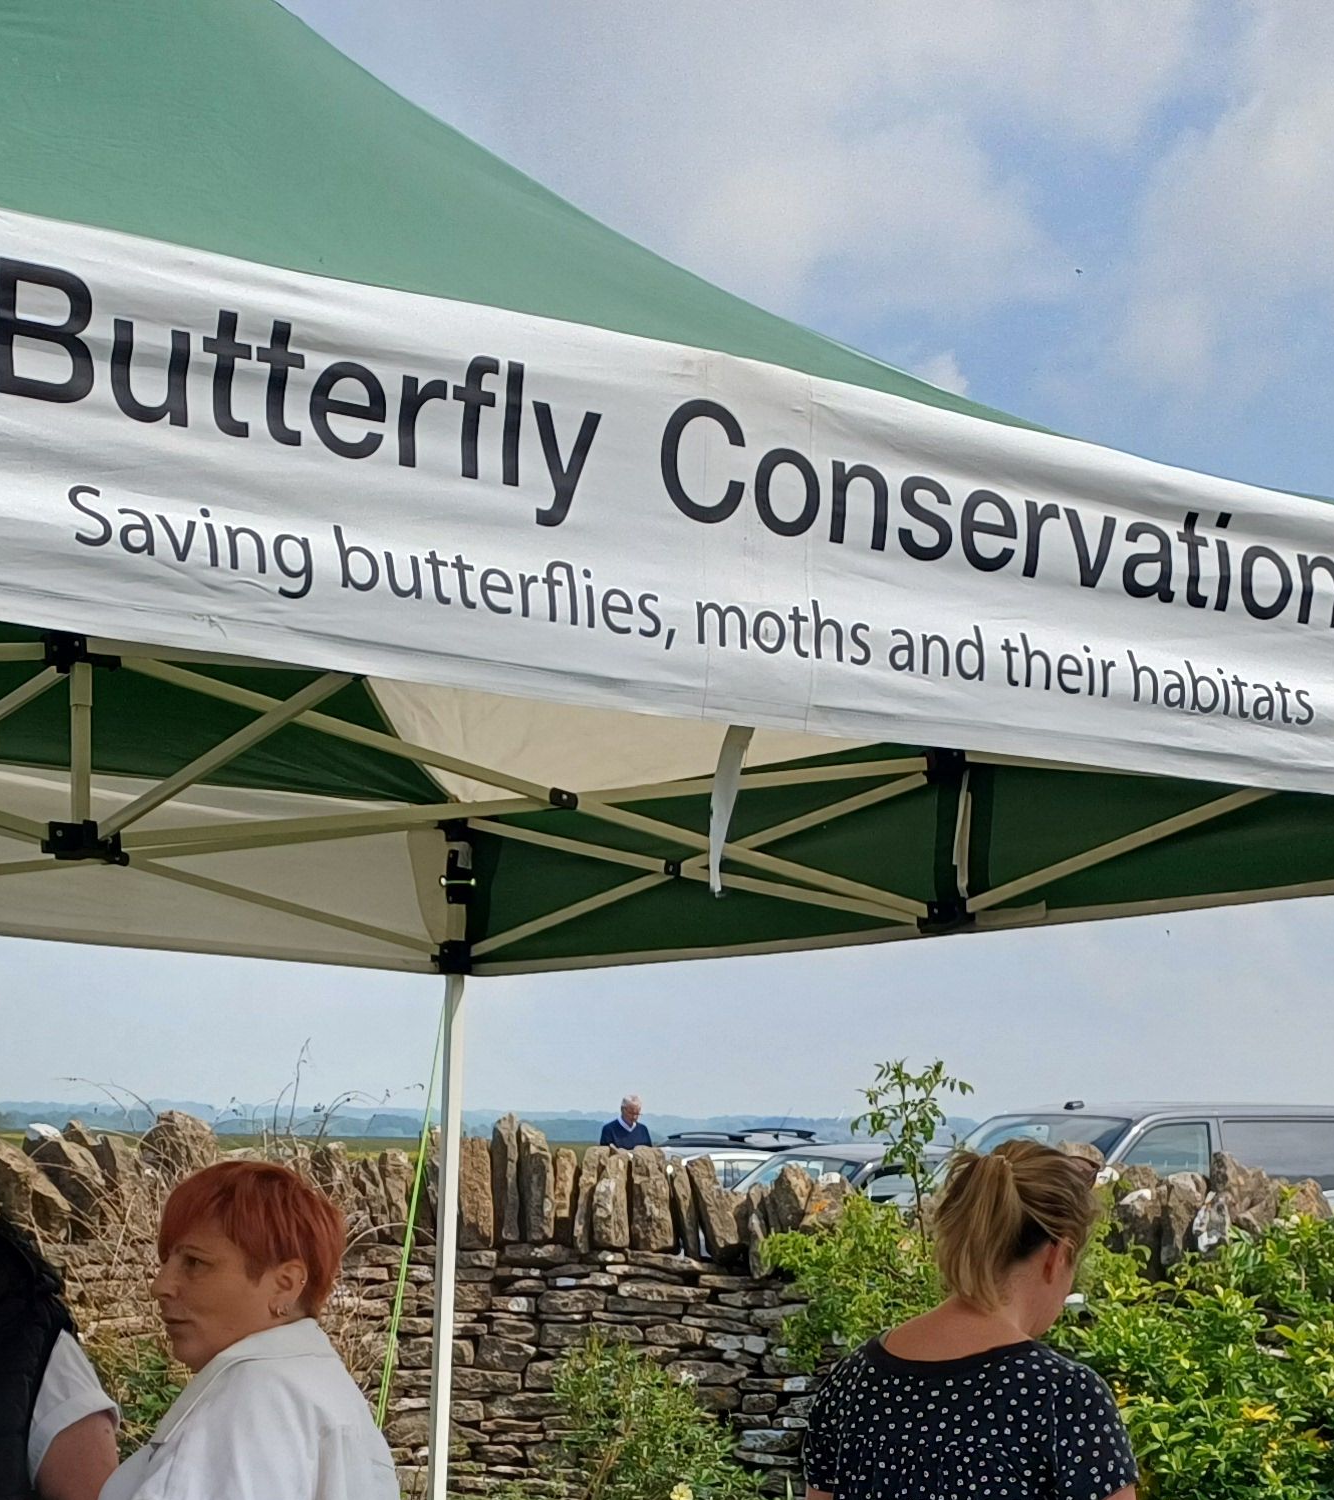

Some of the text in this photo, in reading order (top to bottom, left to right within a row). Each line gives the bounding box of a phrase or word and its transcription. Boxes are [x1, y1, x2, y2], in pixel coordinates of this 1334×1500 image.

[68, 485, 1315, 726] Saving butterflies, moths and their habitats
